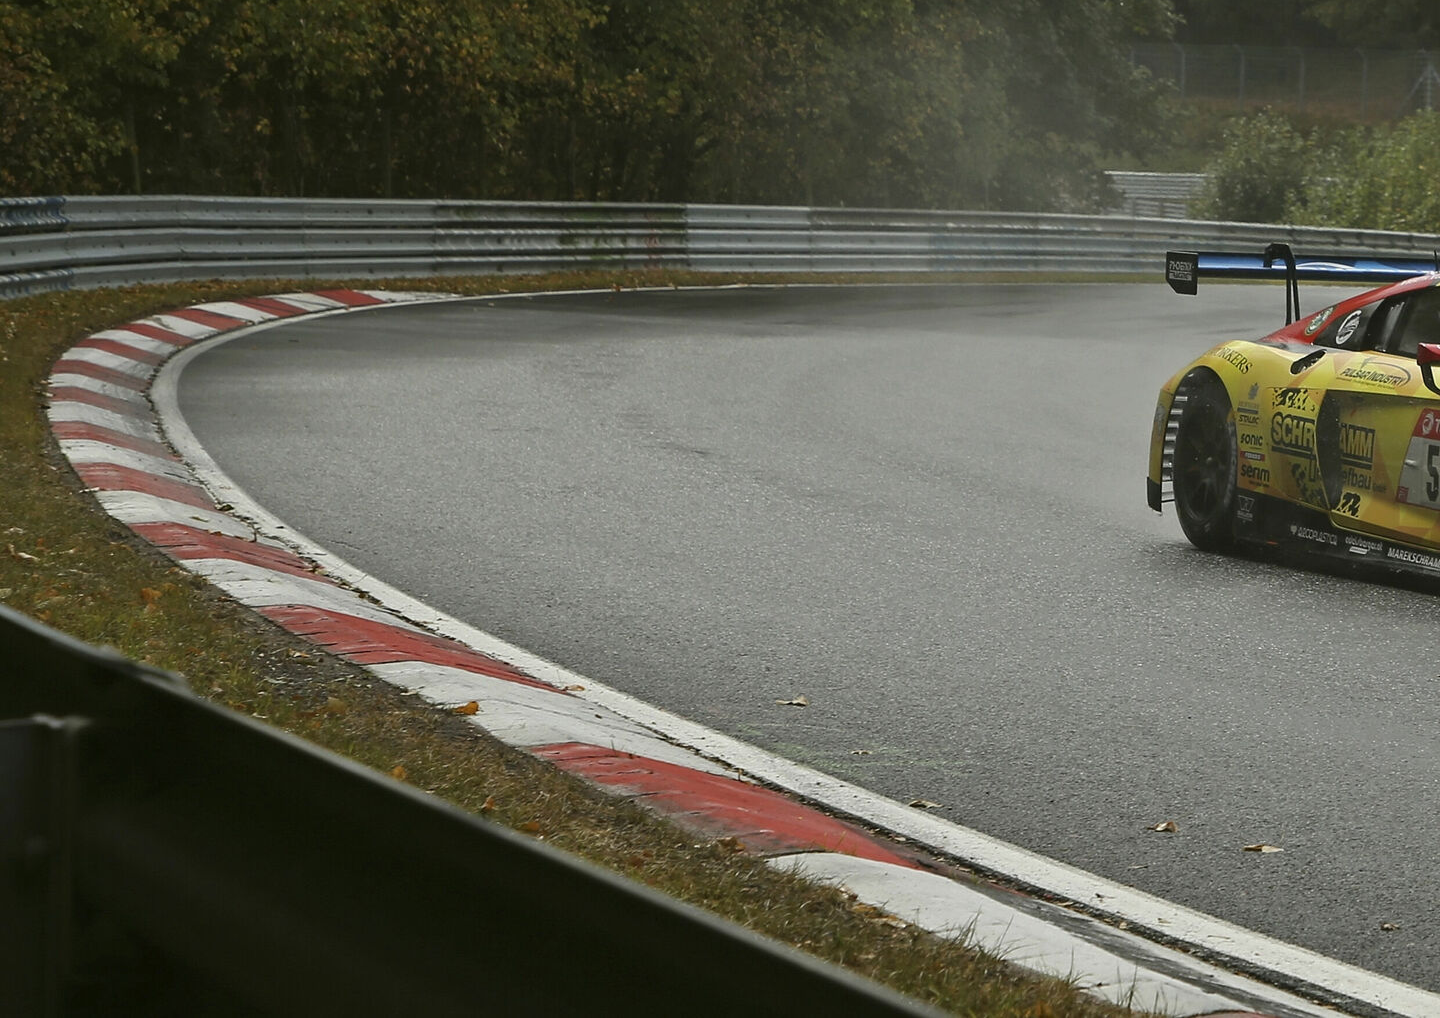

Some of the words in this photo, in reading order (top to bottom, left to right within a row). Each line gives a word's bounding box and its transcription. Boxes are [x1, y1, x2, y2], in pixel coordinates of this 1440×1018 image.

[1340, 367, 1371, 379] PULSAR
[1240, 432, 1263, 447] sonic
[1426, 444, 1440, 502] 5
